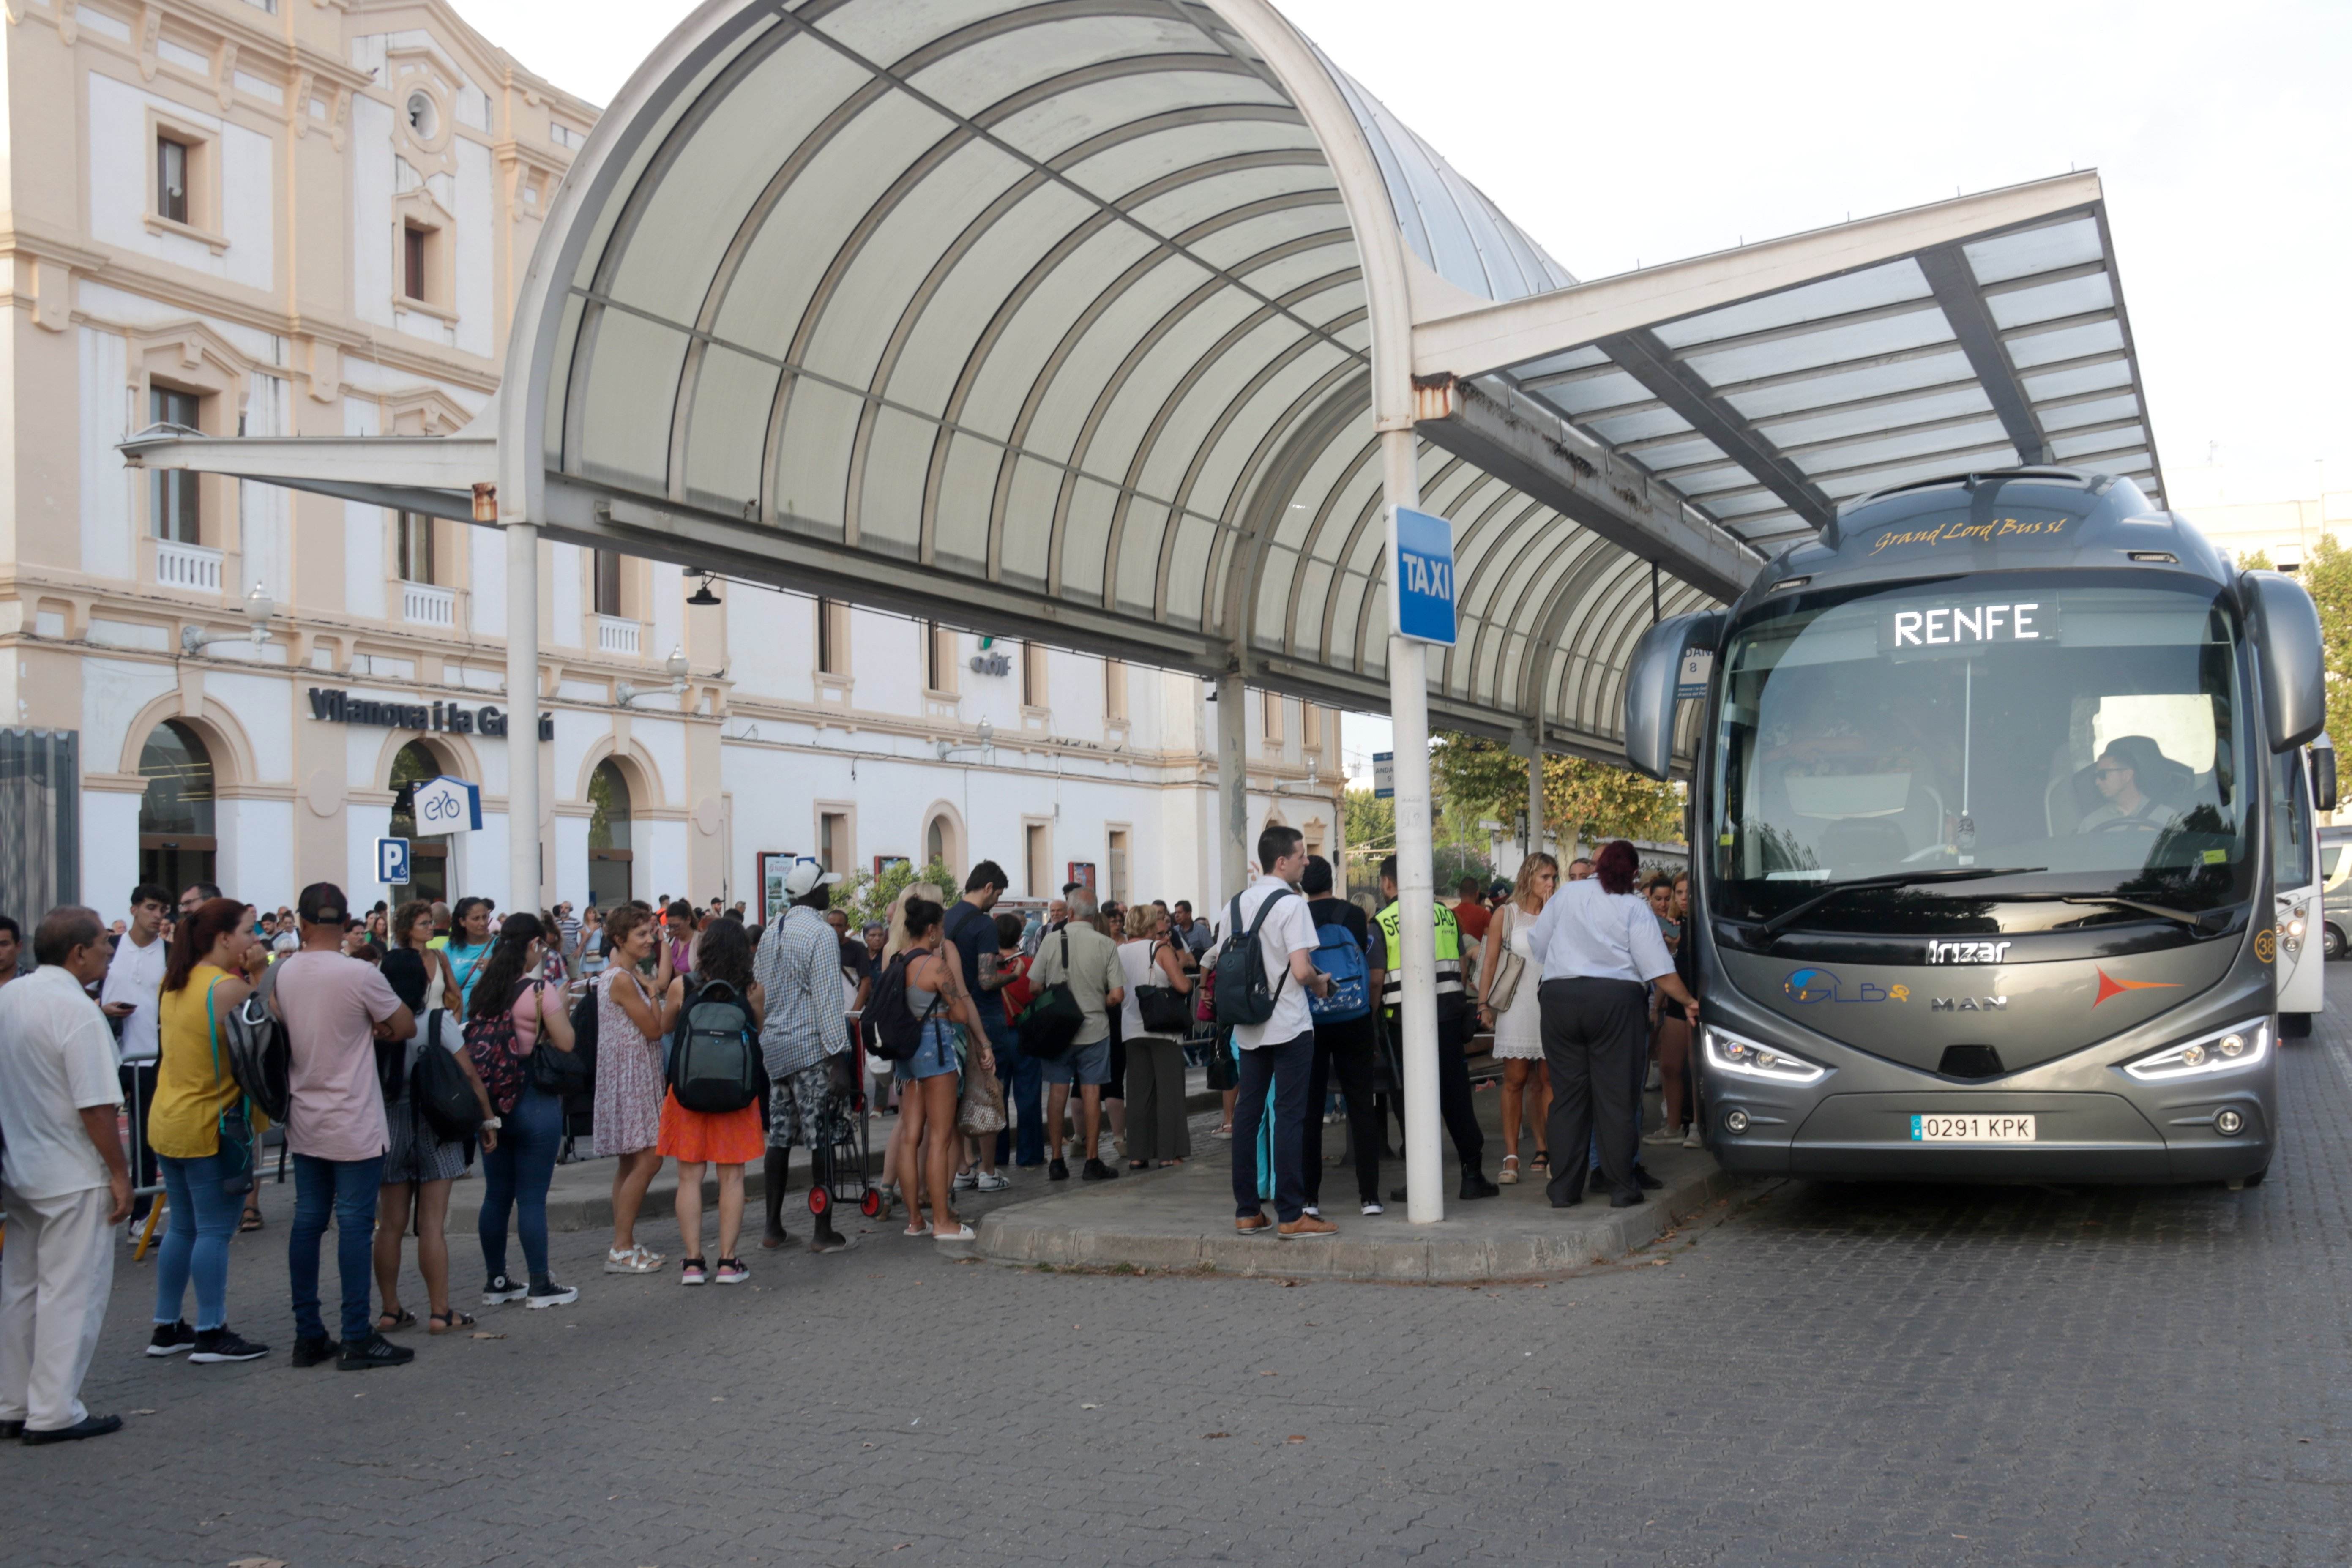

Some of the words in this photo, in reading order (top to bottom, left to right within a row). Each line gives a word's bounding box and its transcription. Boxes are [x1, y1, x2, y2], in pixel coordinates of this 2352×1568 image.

[1867, 523, 1946, 556] Grand
[1942, 519, 1999, 541] Lord
[1997, 518, 2043, 536] Bus
[2044, 518, 2068, 533] sl
[1402, 552, 1450, 600] TAXI
[1895, 604, 2039, 647] RENFE
[1690, 662, 1697, 672] 8
[309, 687, 429, 730] Vilanova
[433, 700, 443, 732] i
[448, 702, 474, 733] la
[384, 843, 403, 878] P
[1926, 940, 2011, 964] Irizar
[2259, 937, 2275, 955] 38
[1931, 996, 2007, 1012] MAN
[1928, 1119, 1978, 1136] 0291
[1989, 1118, 2029, 1137] KPK
